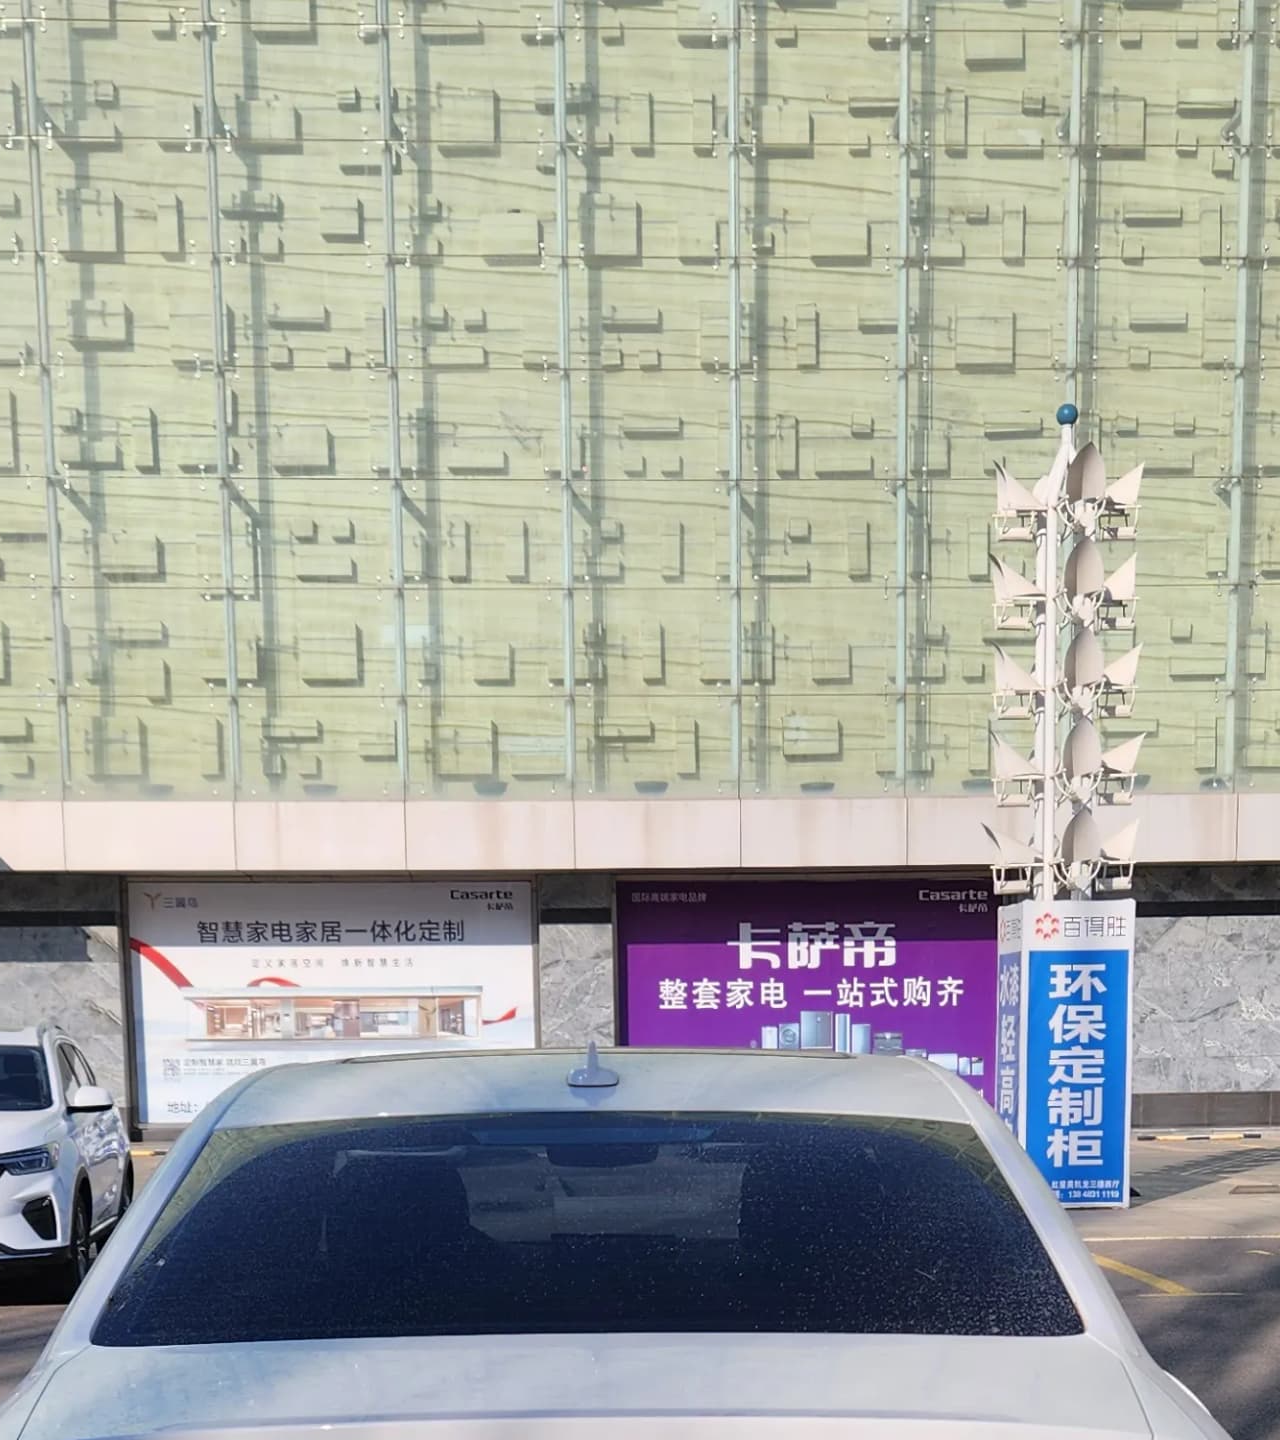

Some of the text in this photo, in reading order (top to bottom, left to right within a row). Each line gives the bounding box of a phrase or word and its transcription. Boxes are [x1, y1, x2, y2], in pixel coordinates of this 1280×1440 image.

[450, 889, 513, 900] Casarte
[919, 889, 988, 901] Casarte
[197, 919, 465, 944] 智慧家电家居一体化定制
[1063, 916, 1126, 938] 百得胜
[726, 921, 897, 970] 卡萨帝
[658, 976, 964, 1010] 整套家电 一站式购齐
[1046, 963, 1107, 1168] 环保定制柜
